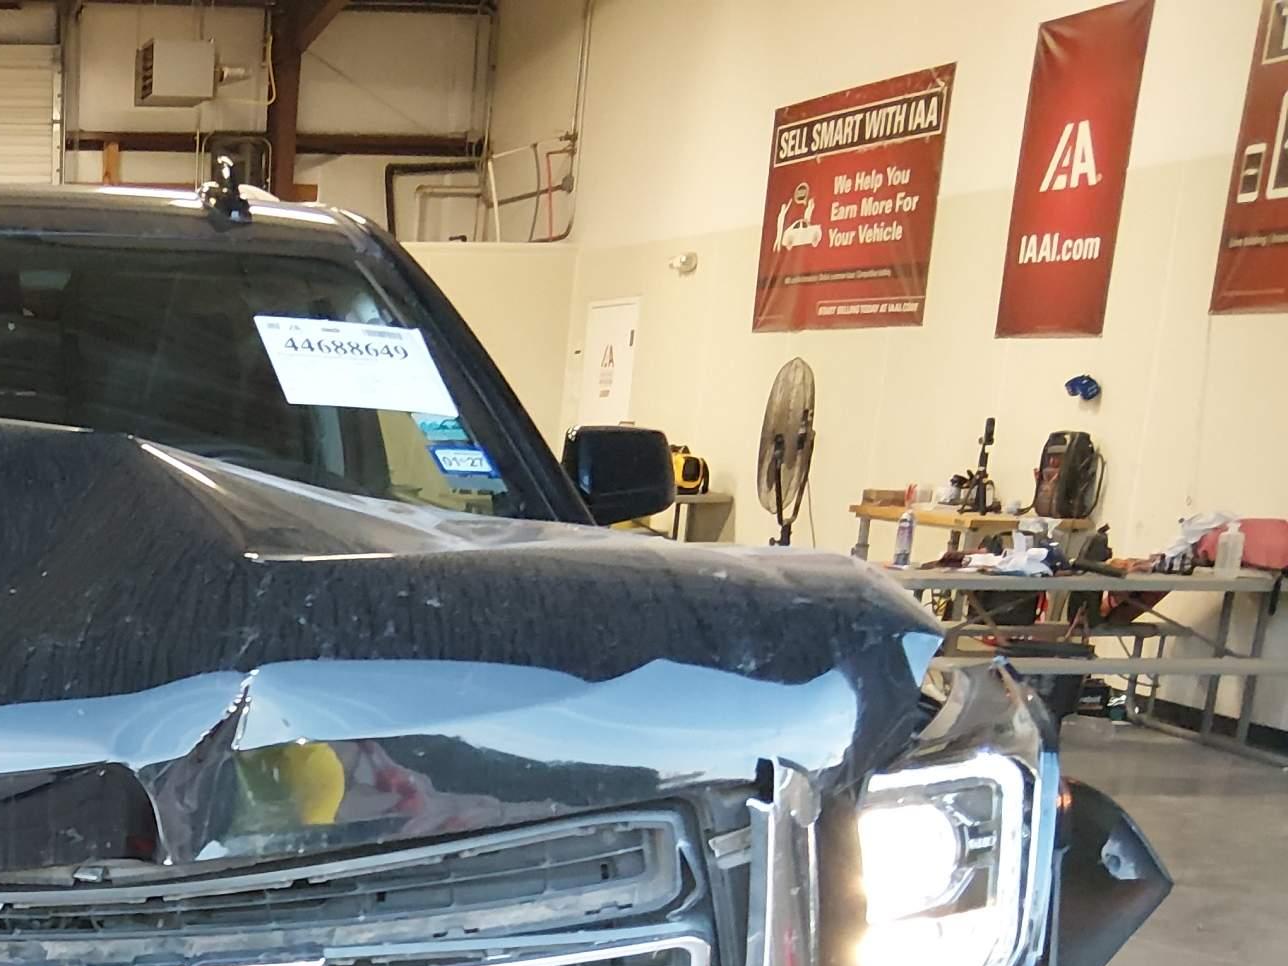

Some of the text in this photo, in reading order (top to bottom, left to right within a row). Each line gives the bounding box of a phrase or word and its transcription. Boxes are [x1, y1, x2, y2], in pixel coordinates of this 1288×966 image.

[779, 96, 938, 159] SELL SMART WITH IAA
[834, 166, 911, 195] We Help You
[831, 192, 919, 221] Earn More For
[829, 221, 903, 248] Your Vehicle
[1018, 233, 1101, 264] IAAI.com
[284, 337, 409, 360] 44688649
